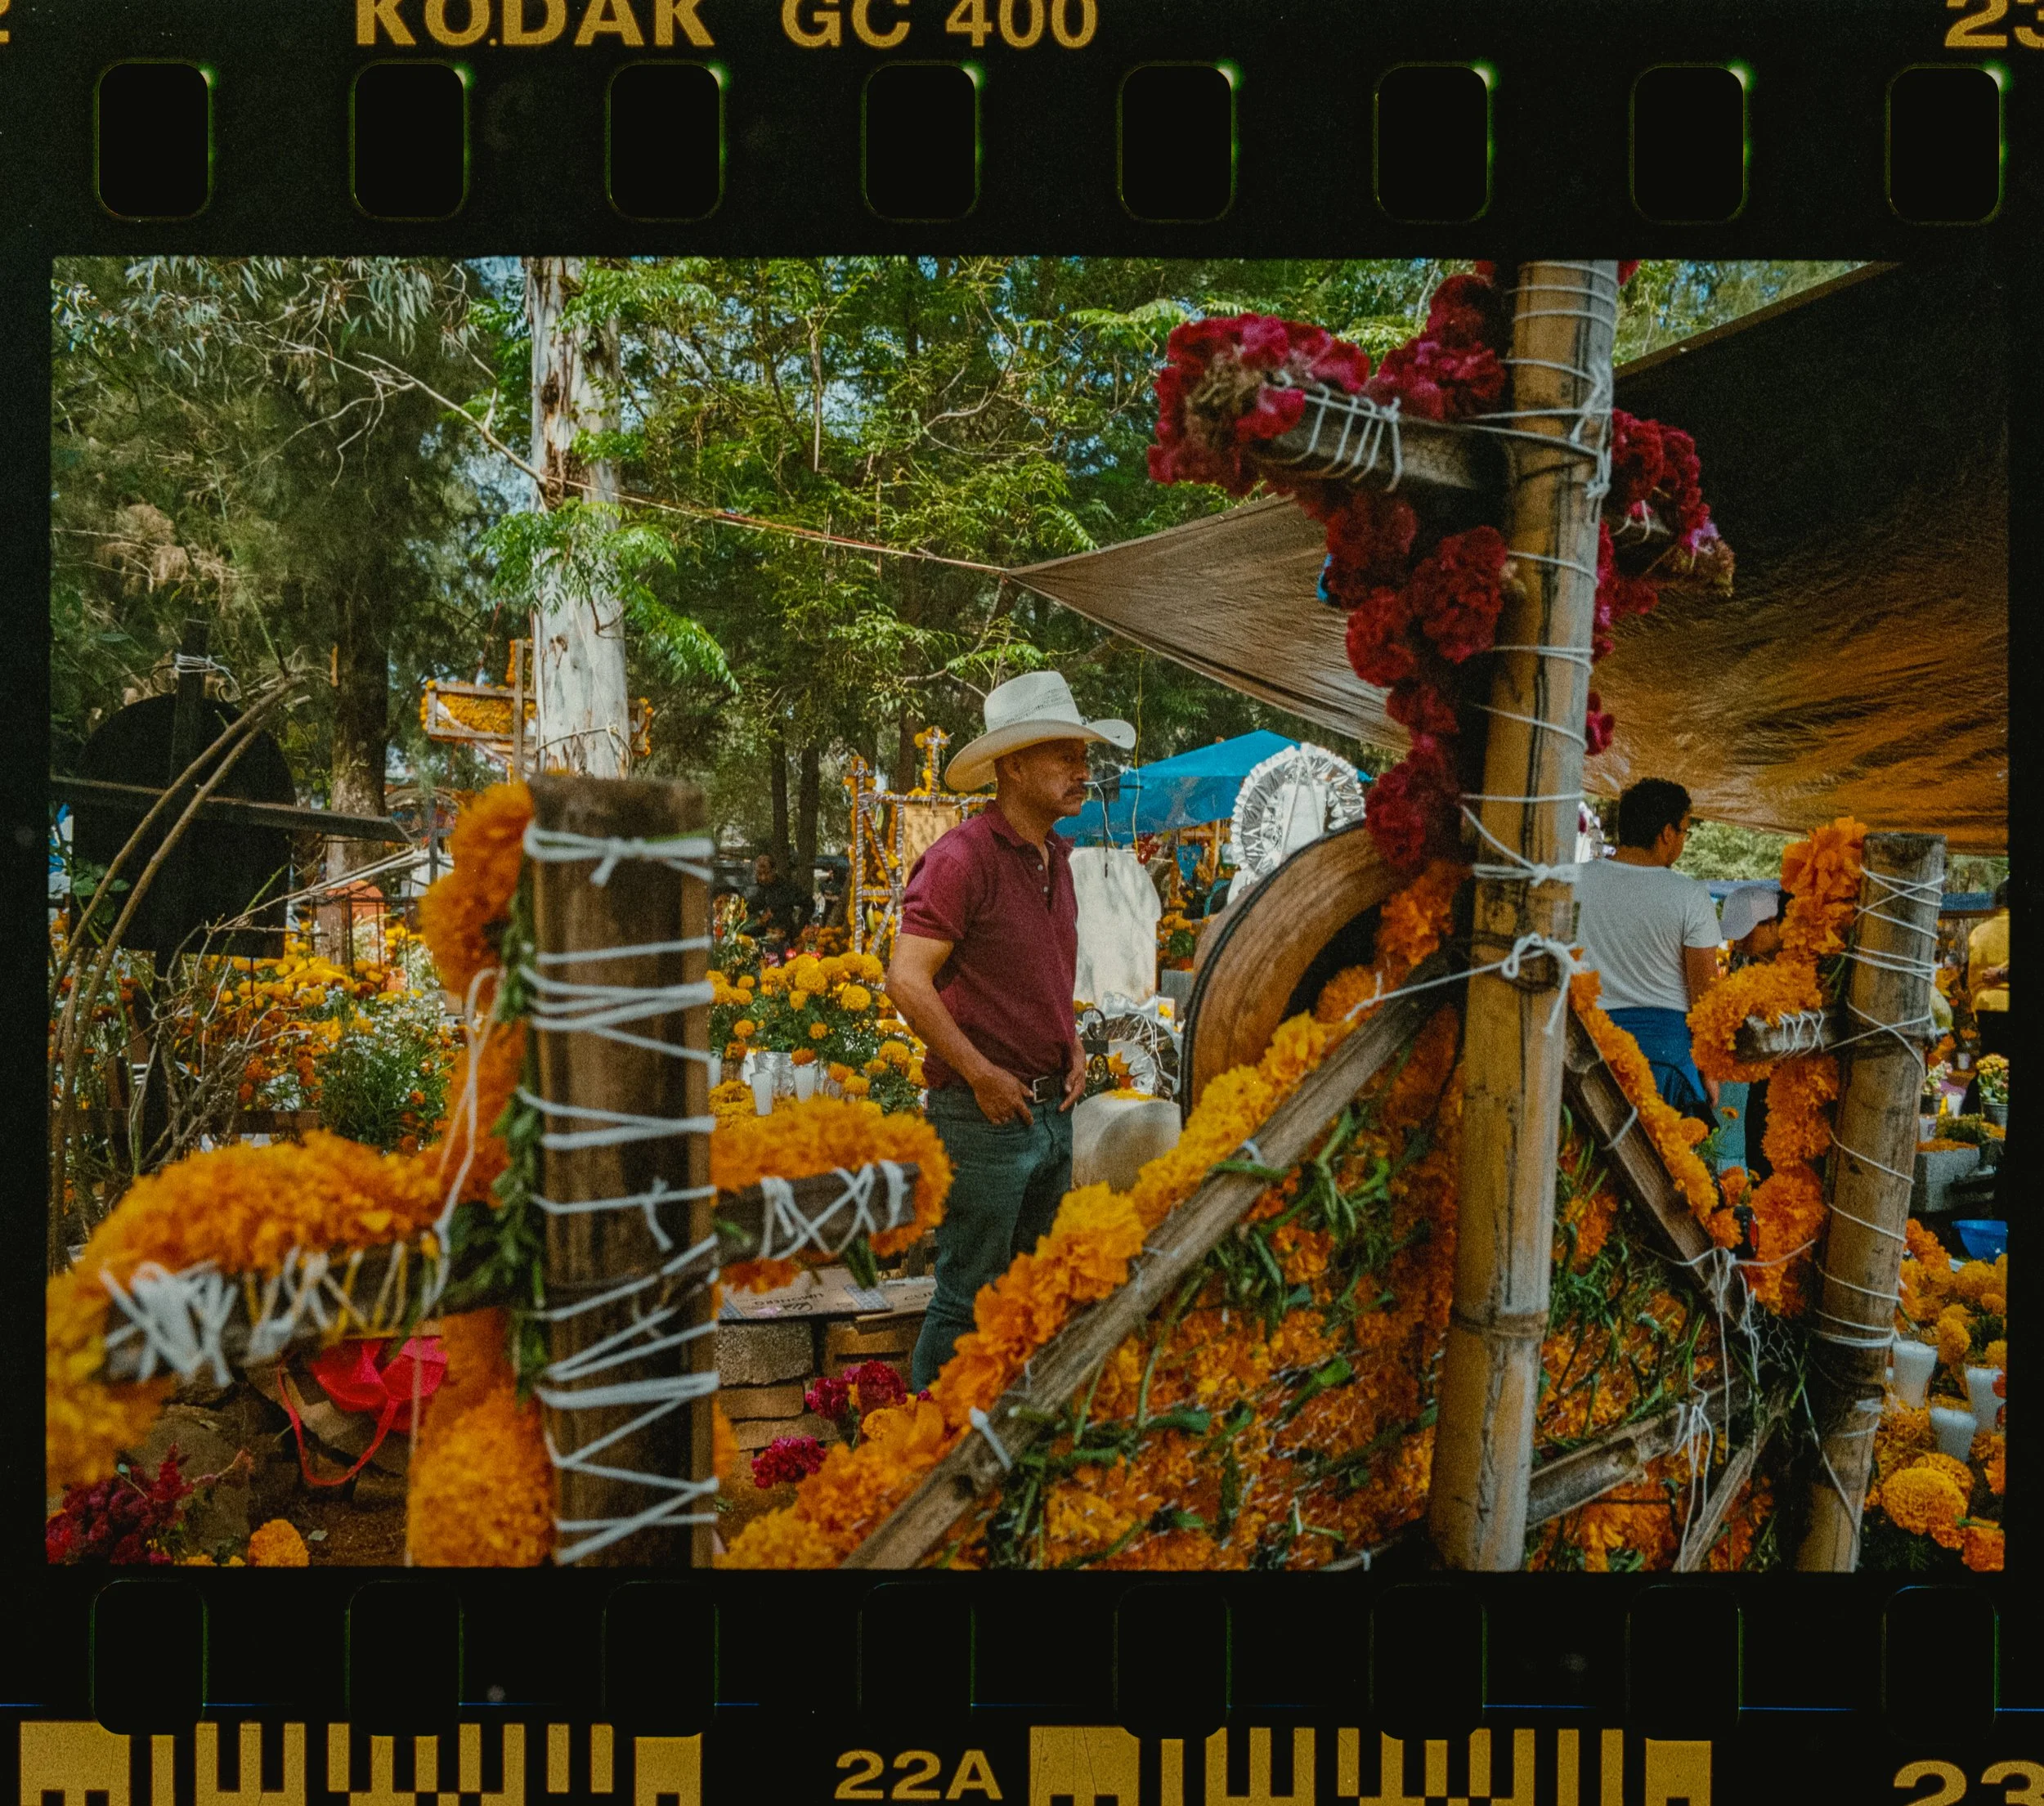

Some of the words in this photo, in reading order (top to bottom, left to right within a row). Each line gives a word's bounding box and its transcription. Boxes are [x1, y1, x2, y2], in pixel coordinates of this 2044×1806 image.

[781, 0, 911, 48] GC
[945, 0, 1098, 48] 400
[834, 1750, 1004, 1800] 22A
